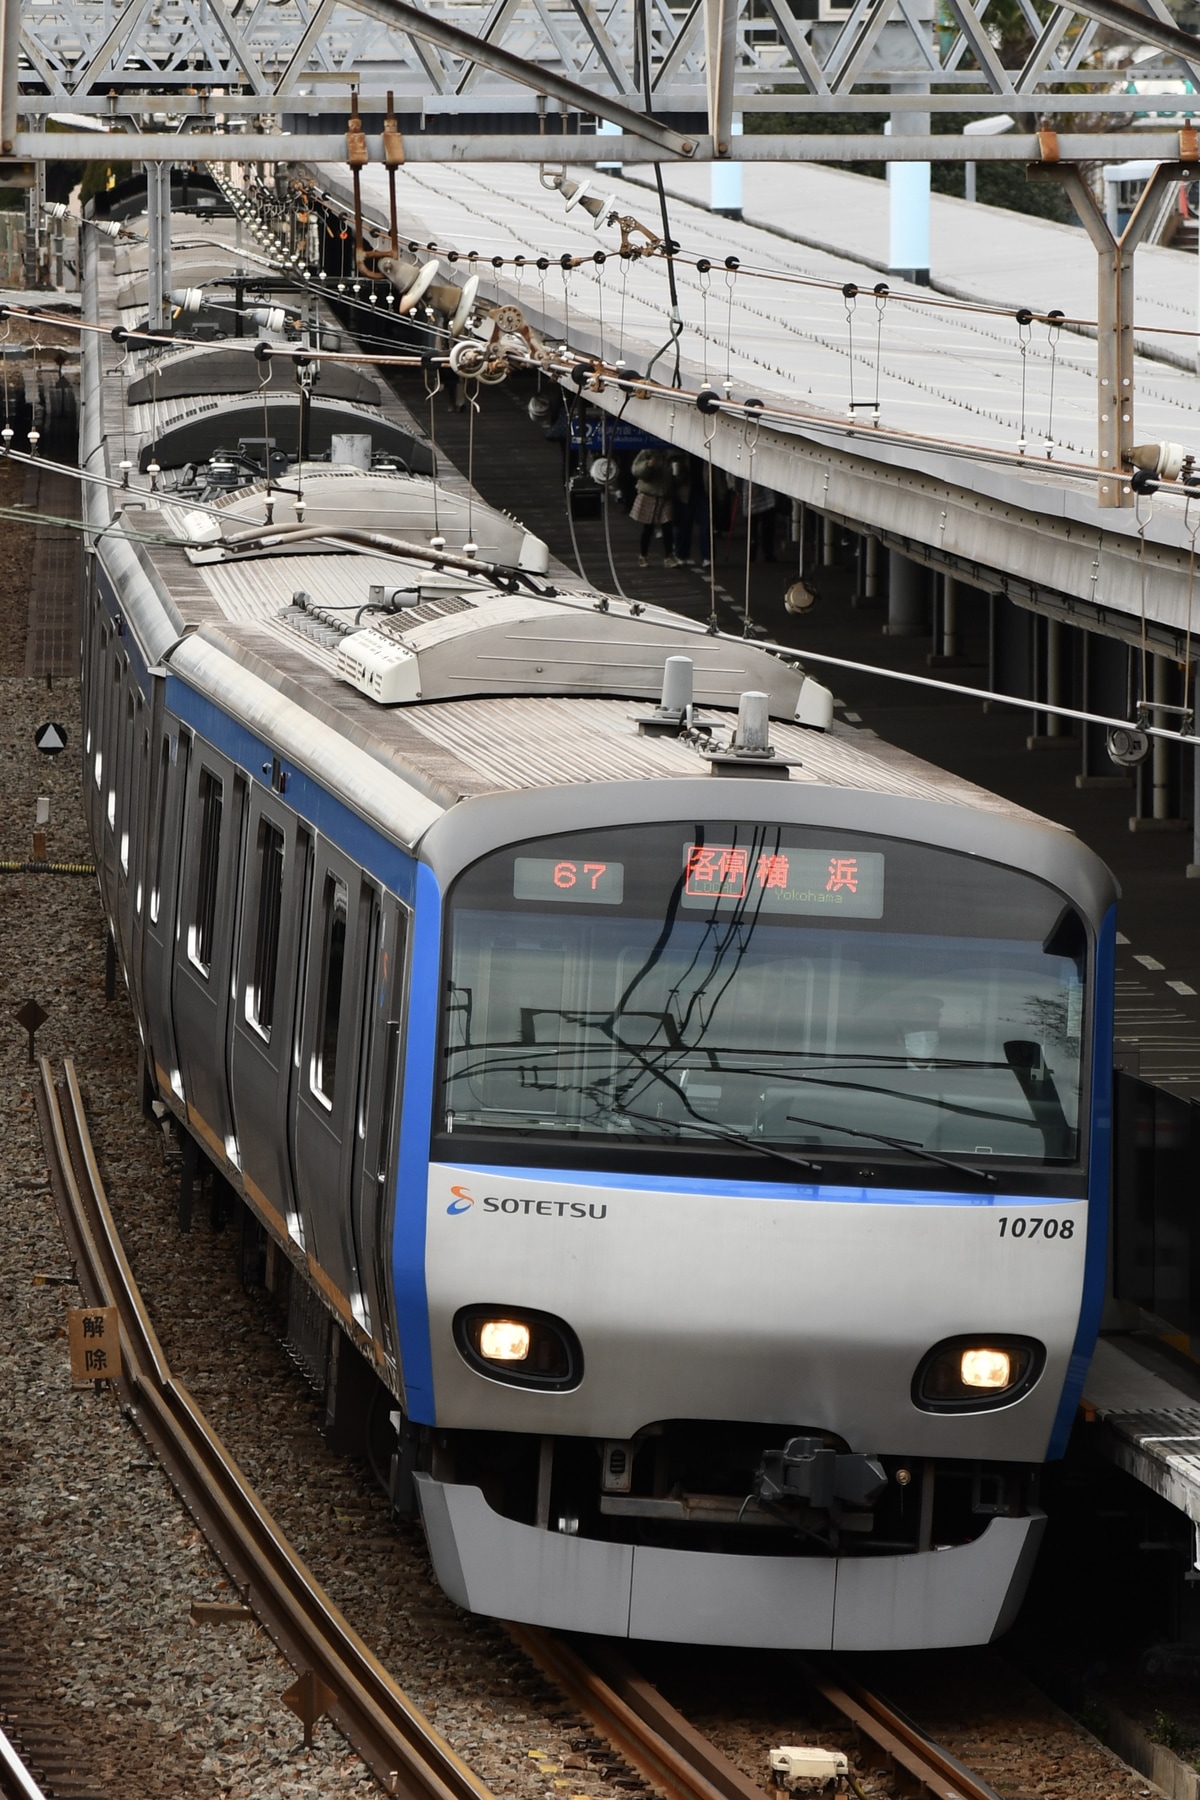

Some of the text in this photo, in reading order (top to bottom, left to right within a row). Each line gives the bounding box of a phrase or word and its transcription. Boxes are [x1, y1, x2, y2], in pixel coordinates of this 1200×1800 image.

[553, 862, 606, 890] 67
[690, 850, 744, 883] 各停
[774, 889, 843, 904] Yokohama
[483, 1197, 607, 1219] SOTETSU
[998, 1217, 1075, 1239] 10708
[82, 1316, 107, 1371] 解除
